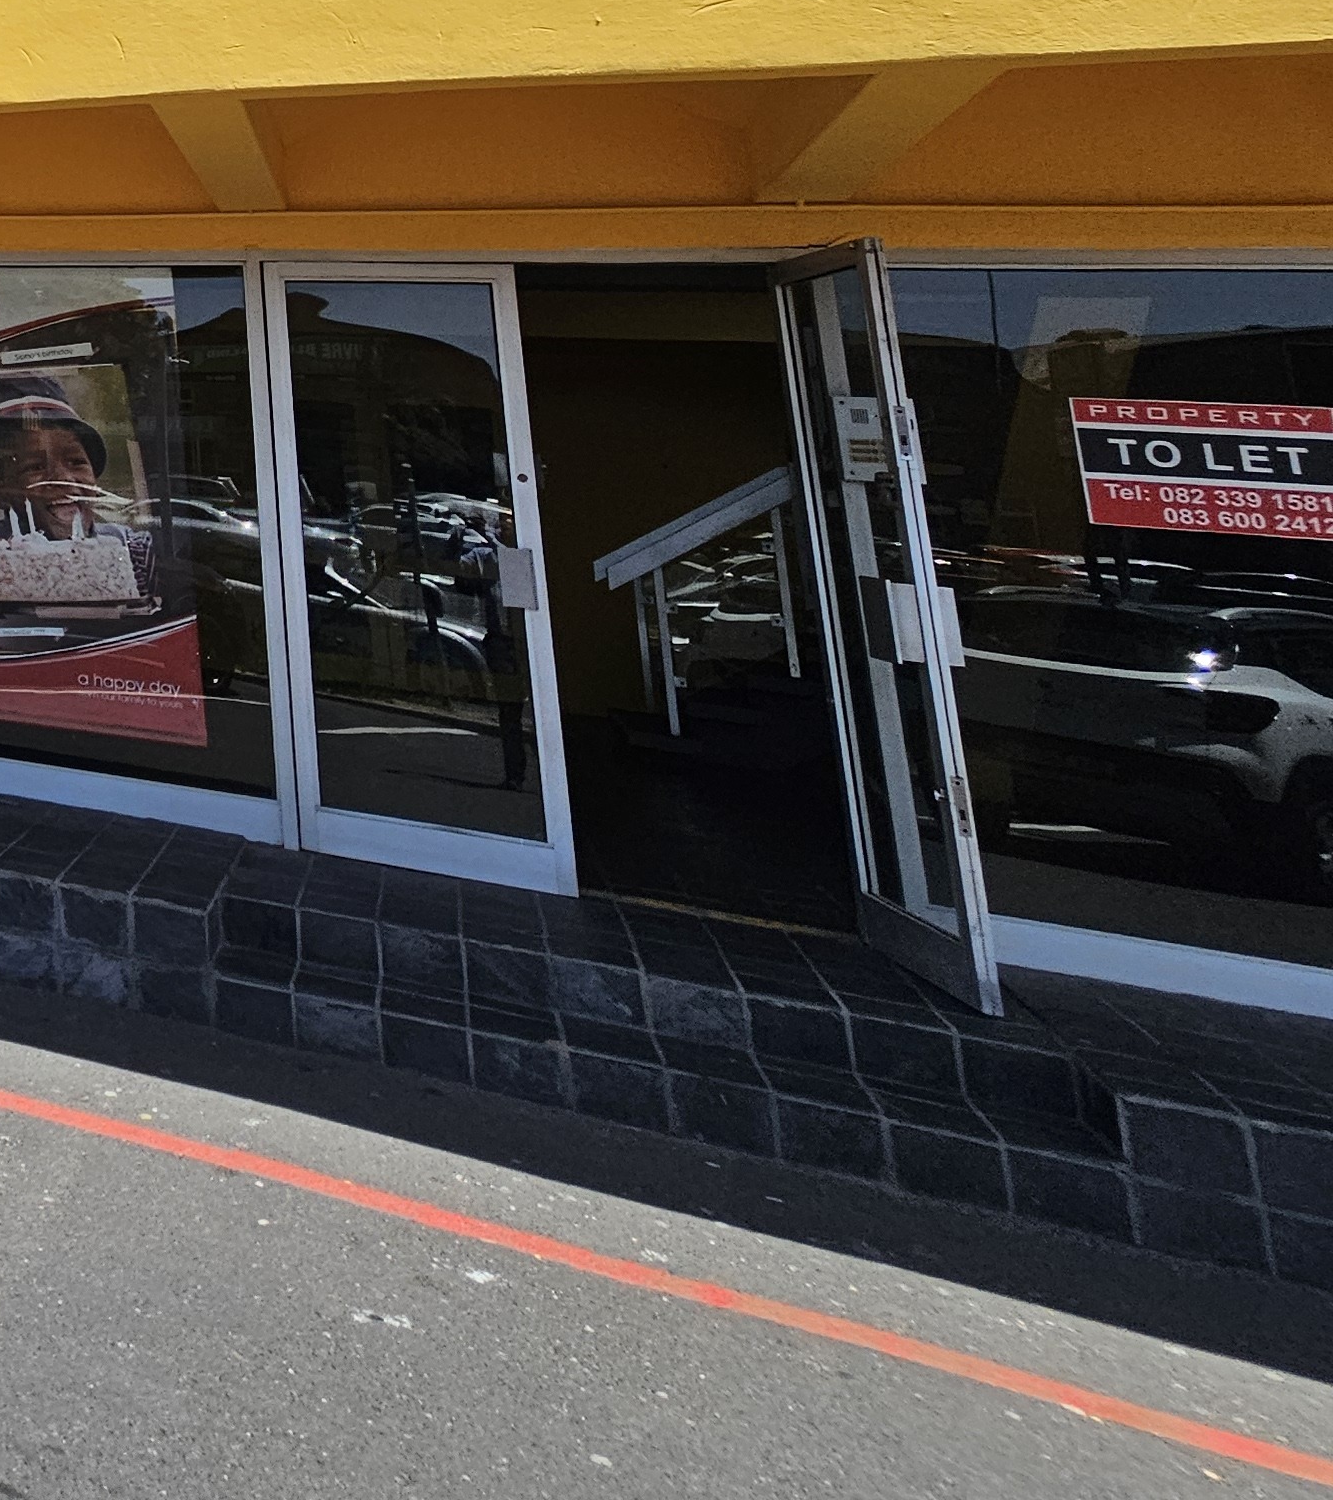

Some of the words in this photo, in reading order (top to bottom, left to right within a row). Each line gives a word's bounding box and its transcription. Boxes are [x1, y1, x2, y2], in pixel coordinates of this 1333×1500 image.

[1089, 404, 1313, 427] PROPERTY
[1106, 437, 1182, 469] TO
[1202, 442, 1310, 476] LET
[1103, 482, 1151, 503] Tel:
[1159, 486, 1207, 505] 082
[1214, 489, 1263, 509] 339
[1271, 493, 1333, 513] 1581
[1163, 506, 1210, 526] 083
[1218, 510, 1267, 530] 600
[77, 673, 89, 686] a
[93, 672, 145, 694] happy
[148, 680, 181, 698] day
